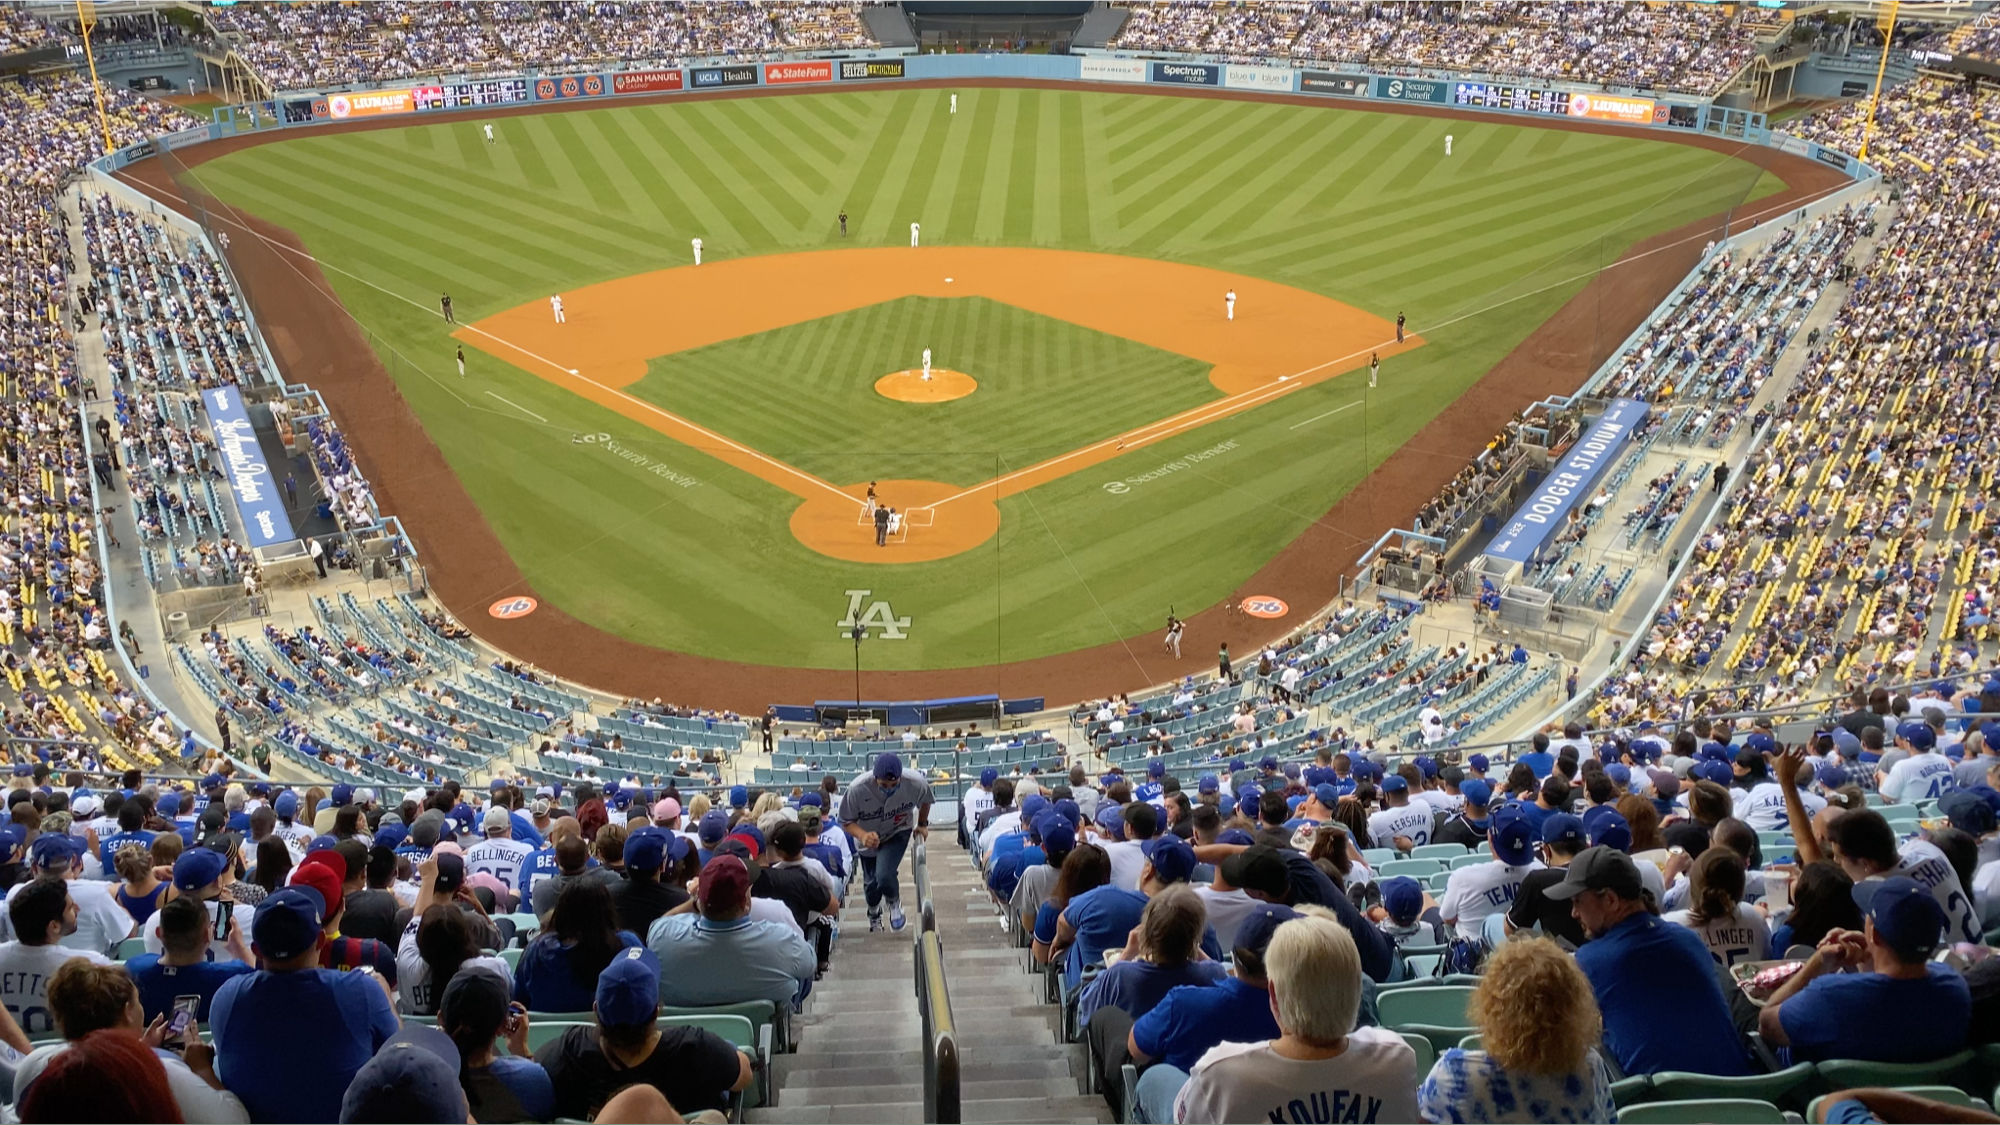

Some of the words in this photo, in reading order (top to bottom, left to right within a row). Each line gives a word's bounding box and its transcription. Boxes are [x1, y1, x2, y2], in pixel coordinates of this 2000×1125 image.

[699, 74, 719, 82] UCLA
[724, 70, 752, 81] Health
[1163, 65, 1206, 76] Spectrum
[645, 73, 679, 82] MANUEL
[540, 85, 552, 95] 76
[564, 82, 576, 92] 76
[588, 80, 599, 90] 76
[1405, 82, 1435, 93] Security
[1405, 90, 1431, 100] Benefit
[316, 102, 328, 113] 76
[1656, 109, 1667, 118] 76
[1125, 460, 1191, 485] Security
[1184, 438, 1240, 463] Benefit
[1523, 472, 1583, 525] DODGER
[1569, 423, 1624, 471] STADIUM
[496, 598, 531, 616] 76
[1250, 600, 1282, 614] 76
[837, 589, 912, 639] LA
[471, 849, 525, 866] BELLINGER
[1268, 1090, 1382, 1124] KOUFAX
